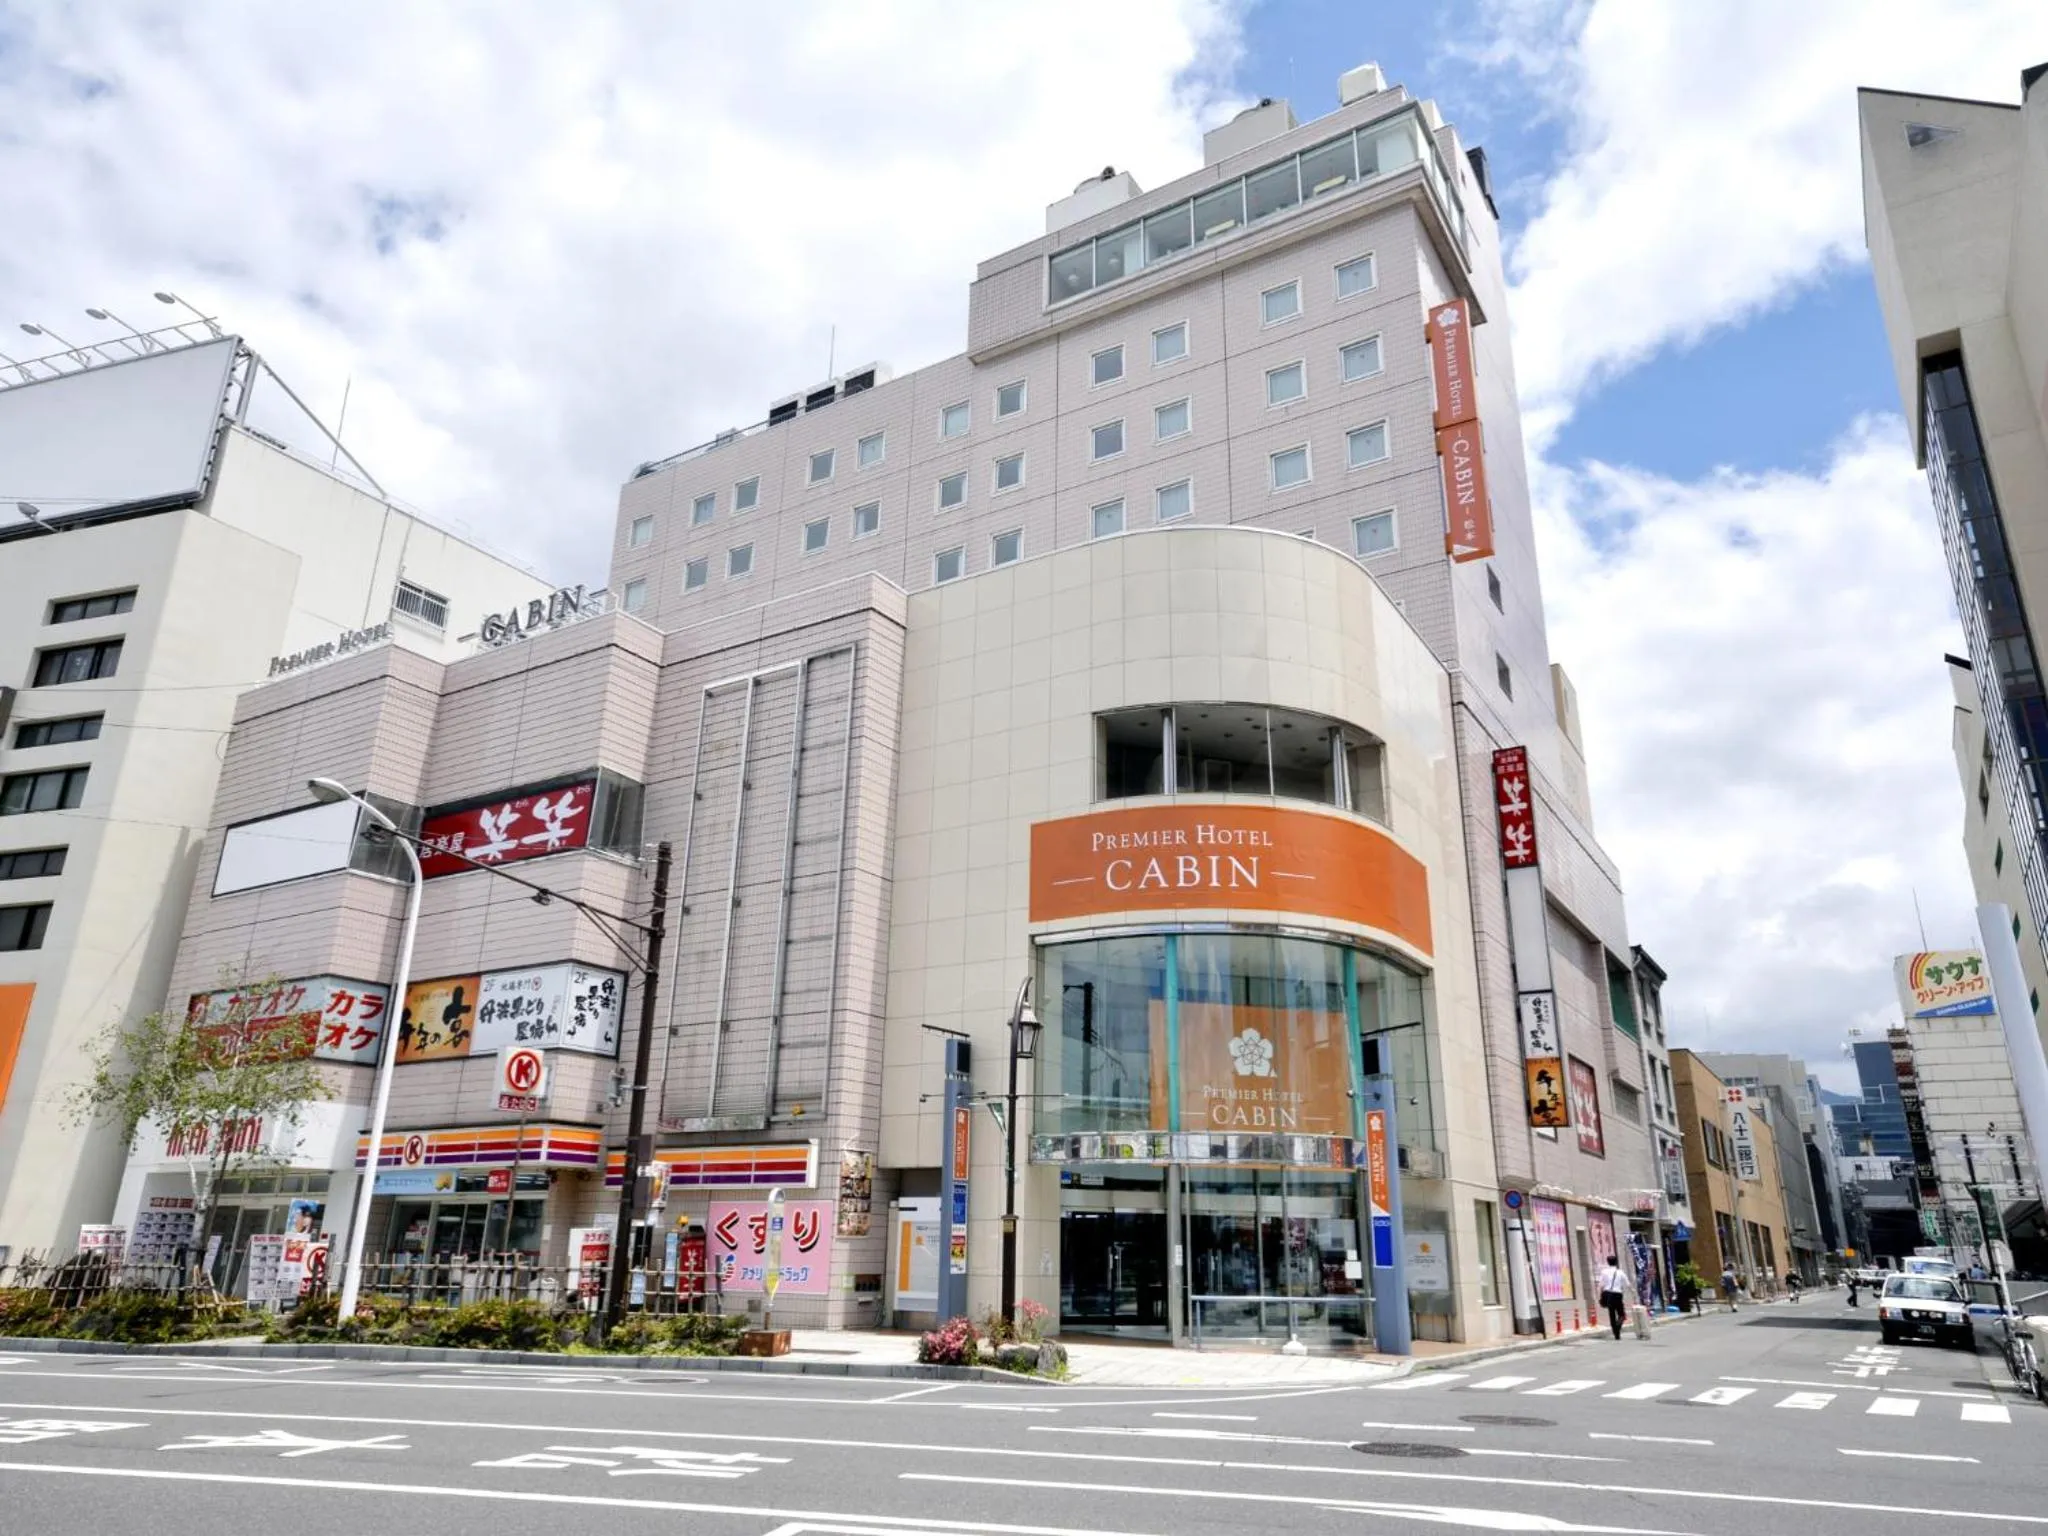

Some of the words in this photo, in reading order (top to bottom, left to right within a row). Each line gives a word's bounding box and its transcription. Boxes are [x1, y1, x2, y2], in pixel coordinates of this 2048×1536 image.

[1452, 439, 1476, 505] CABIN
[480, 584, 586, 643] CABIN
[464, 791, 586, 861] 笑笑
[1092, 828, 1188, 852] PREMIER
[1196, 824, 1274, 848] HOTEL
[1500, 776, 1532, 864] 笑笑
[1105, 855, 1259, 892] CABIN
[1924, 956, 1983, 986] サウナ
[325, 990, 385, 1020] カラ
[322, 1022, 379, 1051] オケ
[1212, 1104, 1298, 1128] CABIN
[1733, 1111, 1754, 1176] 八十二銀行
